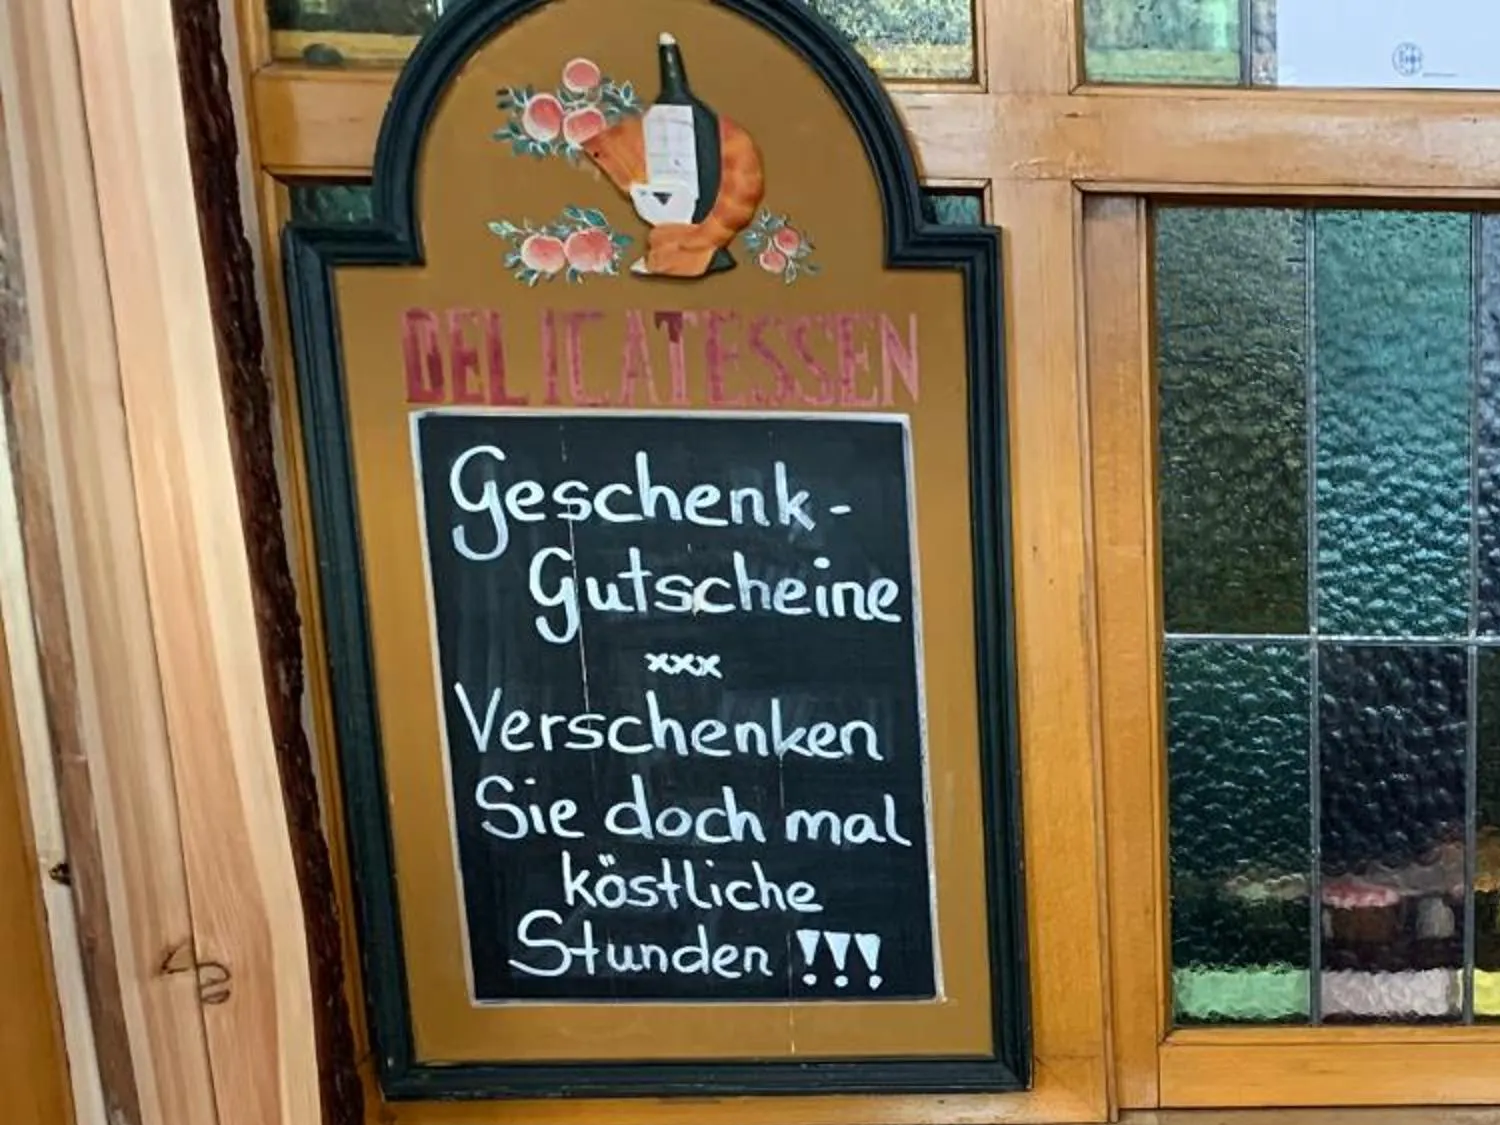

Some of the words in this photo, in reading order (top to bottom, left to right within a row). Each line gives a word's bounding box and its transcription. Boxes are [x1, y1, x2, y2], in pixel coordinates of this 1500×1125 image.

[402, 307, 922, 407] DELICATESSEN
[449, 445, 852, 561] Geschenk-
[528, 546, 902, 644] Gutscheine
[454, 682, 884, 761] Verschenken
[475, 775, 585, 840] Sie
[604, 773, 767, 844] doch
[785, 793, 912, 847] mal
[561, 850, 824, 914] köstliche
[508, 909, 774, 979] Stunden
